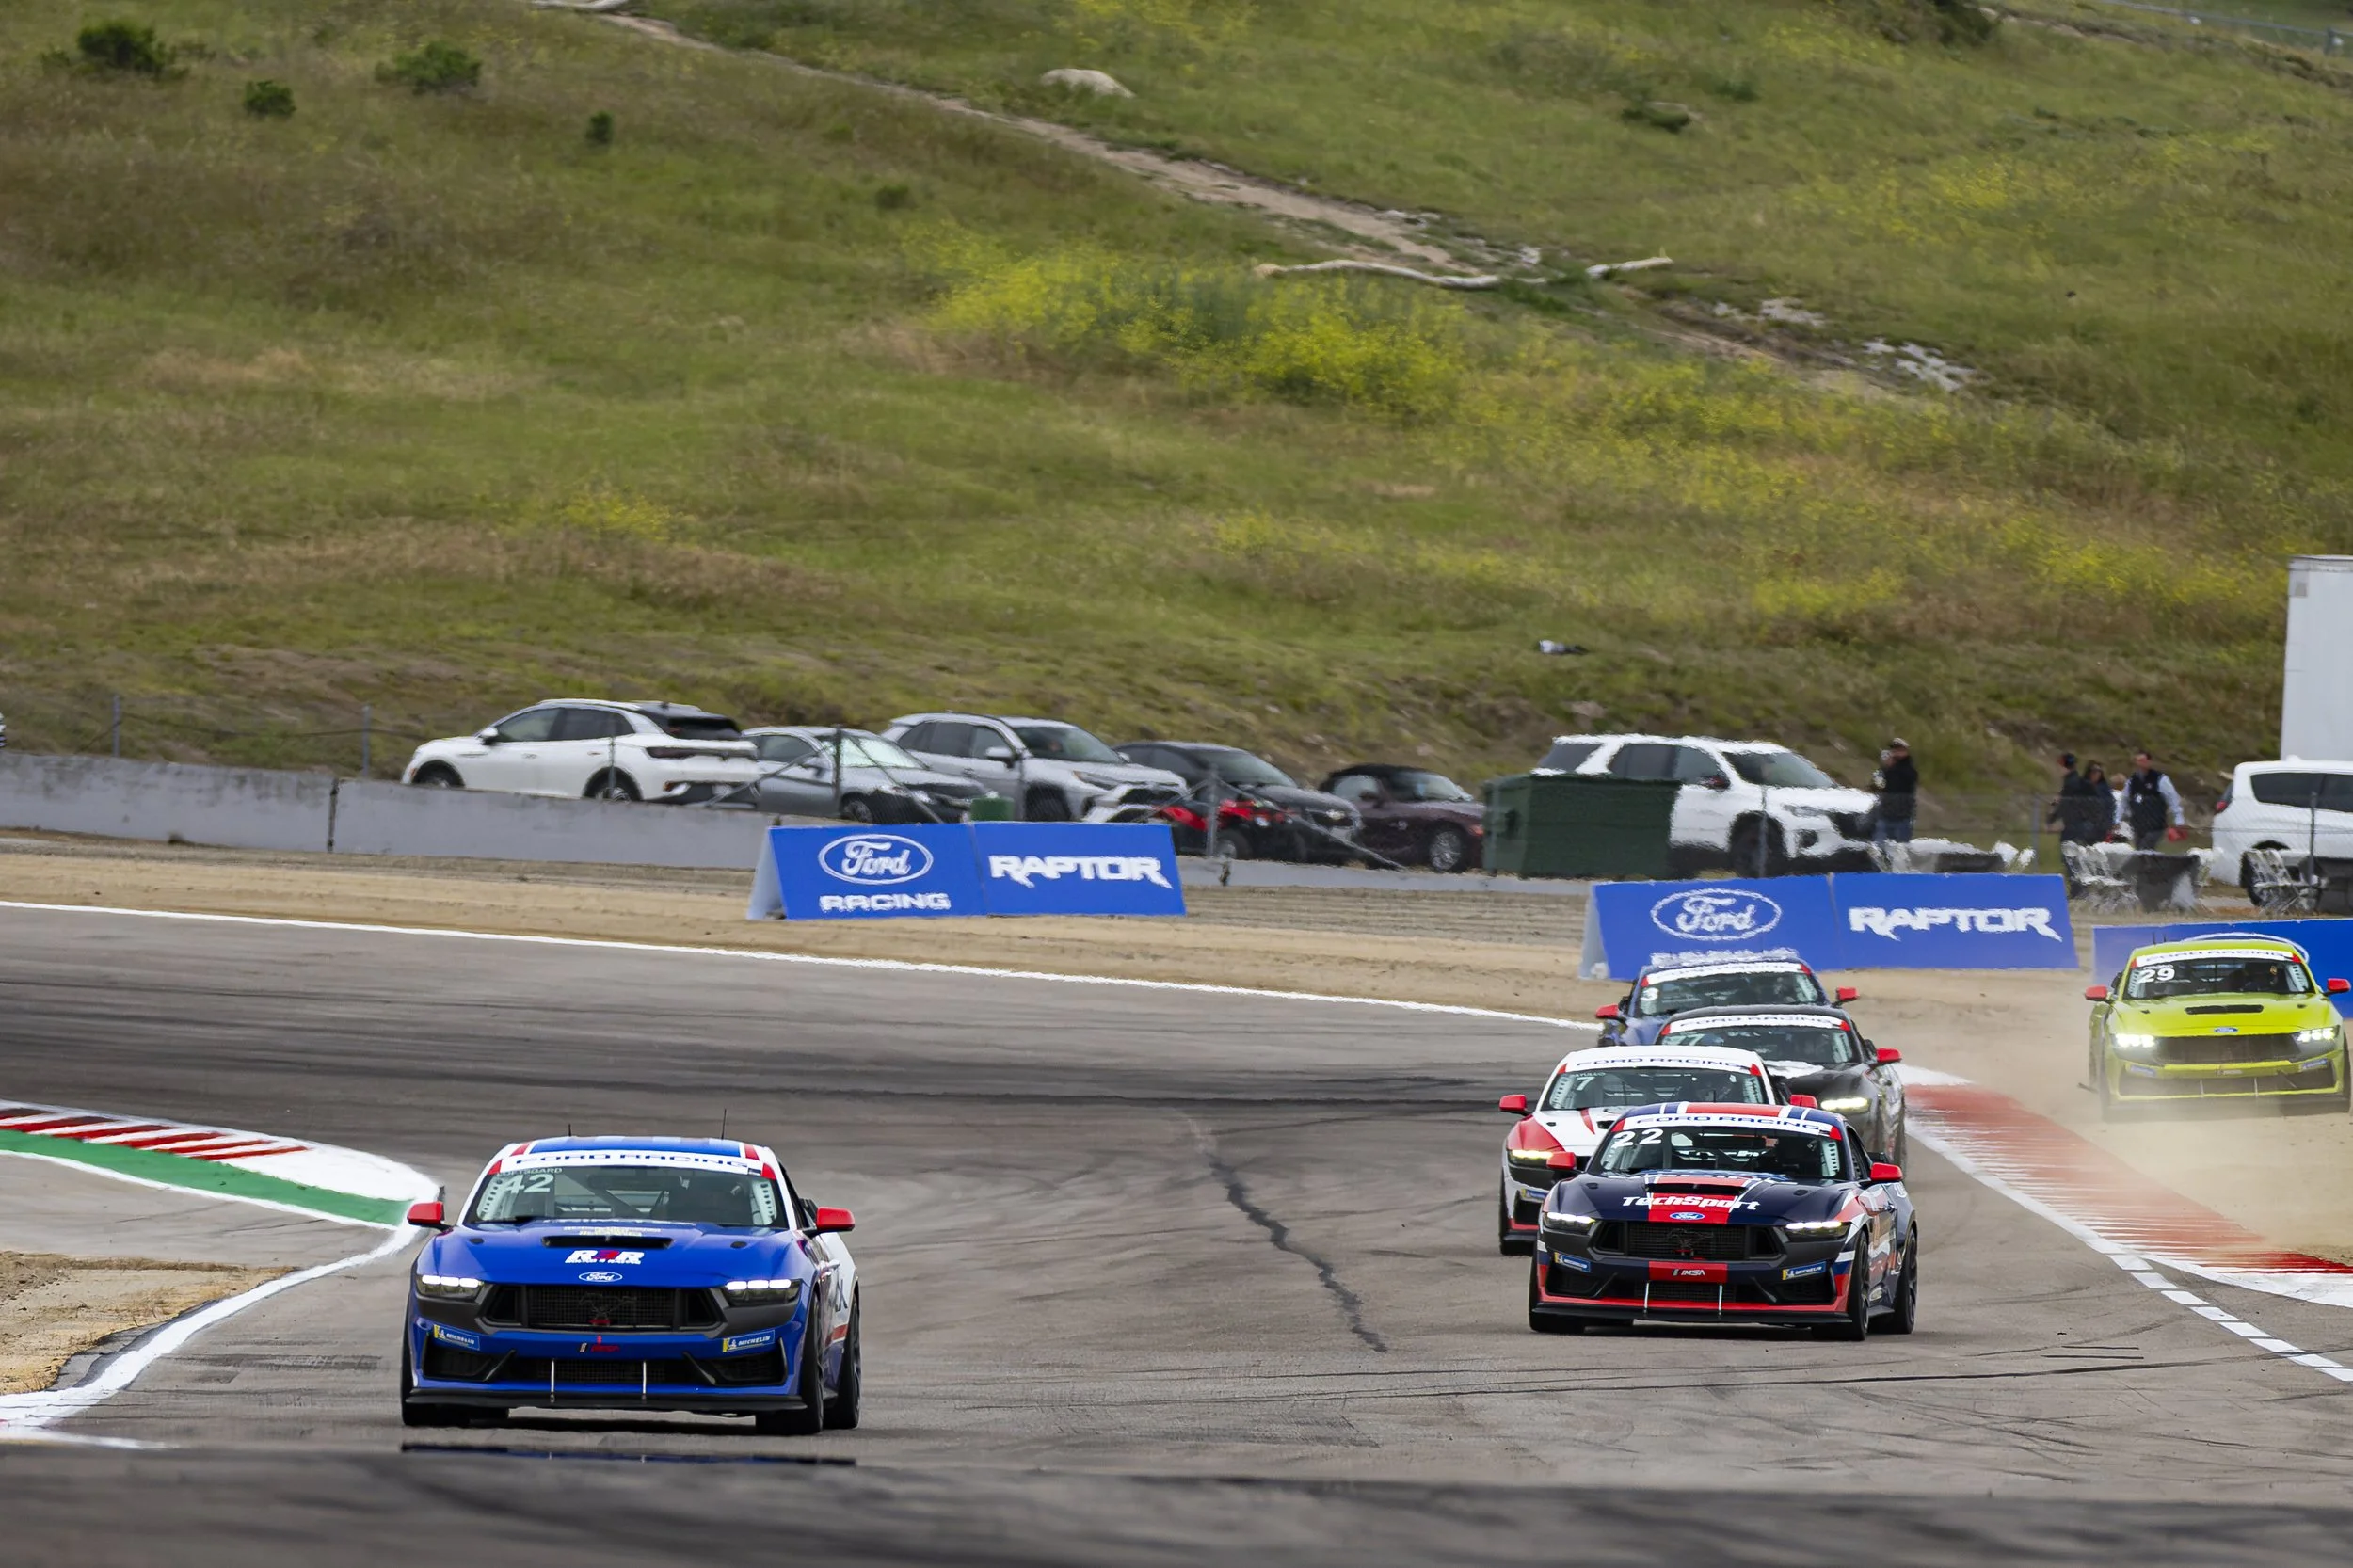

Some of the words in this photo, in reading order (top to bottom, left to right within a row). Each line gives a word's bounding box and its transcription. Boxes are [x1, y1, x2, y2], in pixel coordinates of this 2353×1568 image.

[841, 840, 912, 876] Ford
[988, 855, 1174, 889] RAPTOR
[819, 893, 952, 912] RACING
[1675, 896, 1757, 932] Ford
[1848, 907, 2063, 942] RAPTOR
[2137, 967, 2176, 984] 29
[1577, 1058, 1643, 1066] FORD
[1649, 1058, 1744, 1068] RACING
[1576, 1076, 1595, 1091] 7
[1719, 1116, 1820, 1130] RACING
[1611, 1128, 1664, 1147] 22
[516, 1153, 611, 1164] FORD
[620, 1153, 749, 1168] RACING
[504, 1173, 554, 1194] 42
[1623, 1195, 1761, 1210] TechSport
[738, 1336, 771, 1347] MICHELIN
